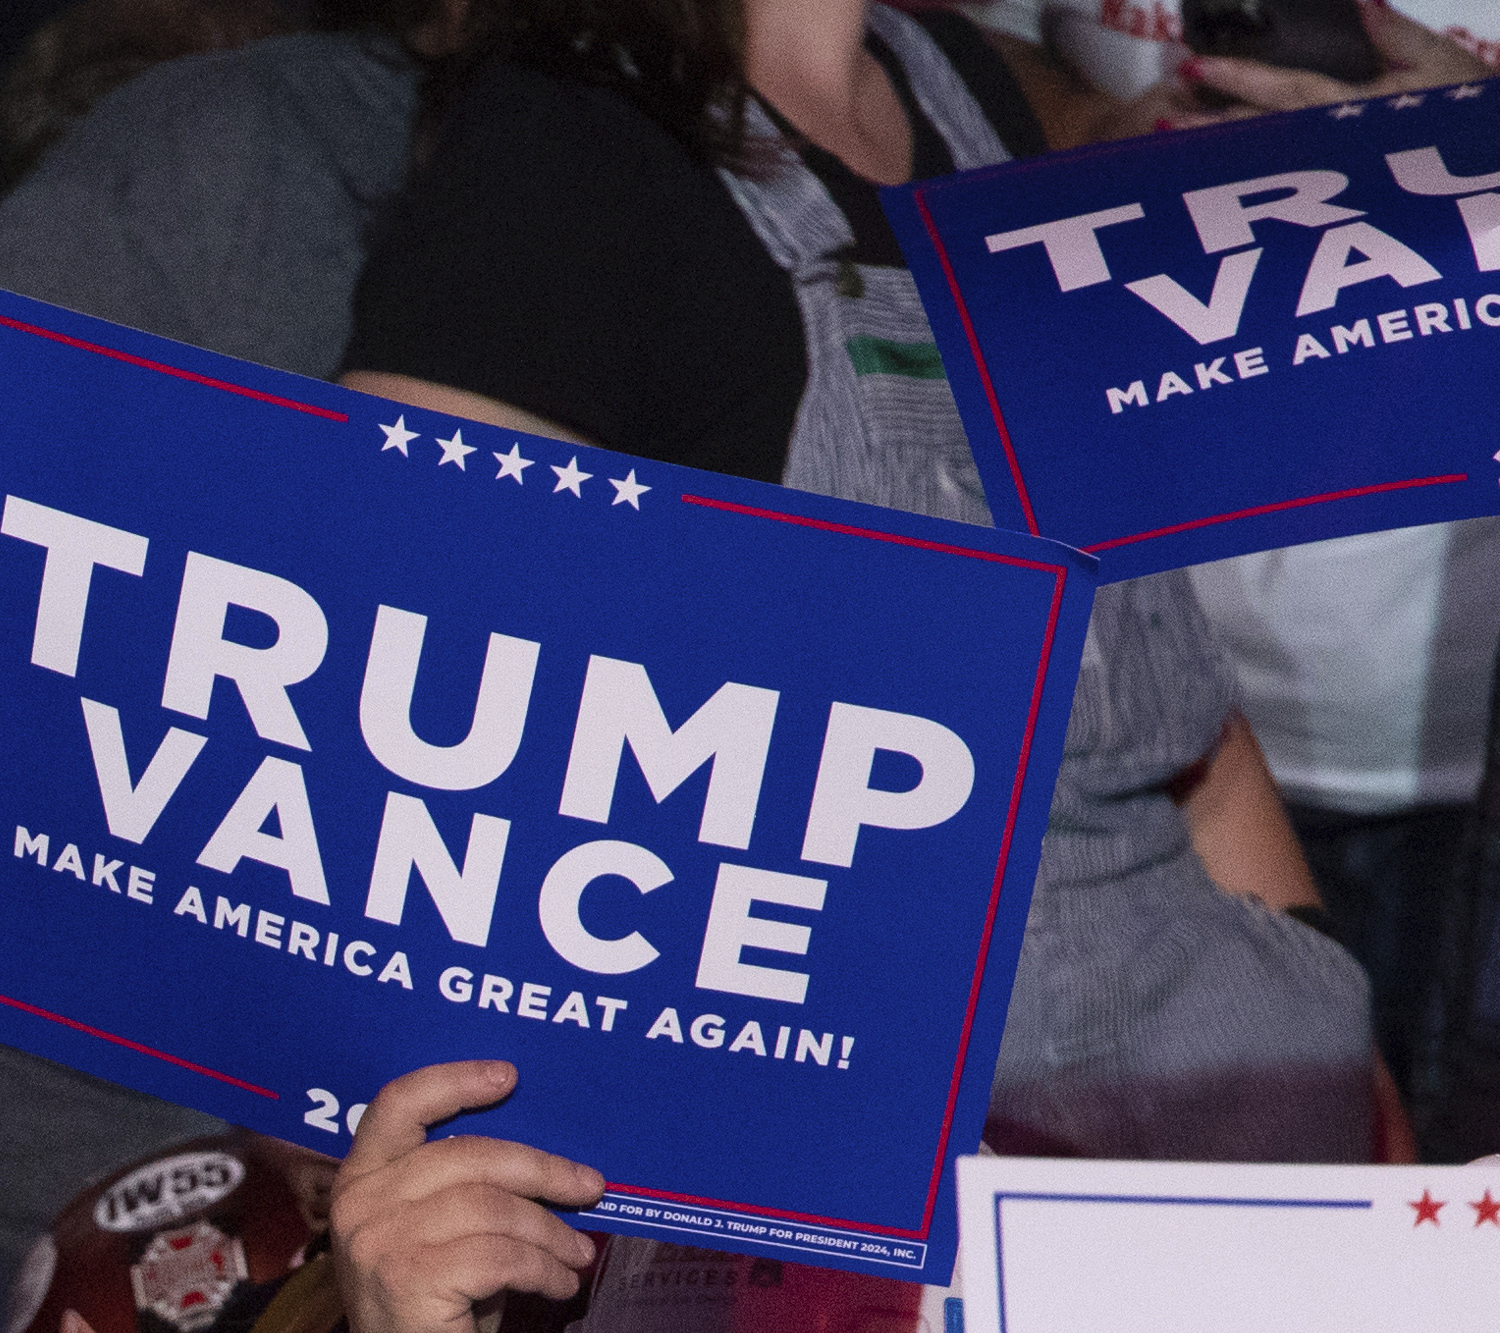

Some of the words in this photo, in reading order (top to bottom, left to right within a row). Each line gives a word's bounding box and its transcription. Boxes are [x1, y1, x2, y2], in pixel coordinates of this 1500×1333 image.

[1107, 347, 1269, 414] MAKE
[0, 493, 976, 870] TRUMP
[12, 825, 156, 906] MAKE
[174, 886, 416, 990] AMERICA
[438, 967, 628, 1033] GREAT
[646, 1004, 856, 1071] AGAIN!
[80, 696, 837, 1004] VANCE
[595, 1201, 617, 1212] AID
[619, 1204, 643, 1217] FOR
[645, 1208, 661, 1220] BY
[663, 1210, 713, 1227] DONALD
[714, 1218, 725, 1230] J.
[726, 1220, 767, 1236] TRUMP
[768, 1227, 793, 1240] FOR
[795, 1231, 860, 1251] PRESIDENT
[860, 1242, 891, 1257] 2024,
[892, 1247, 917, 1260] INC.
